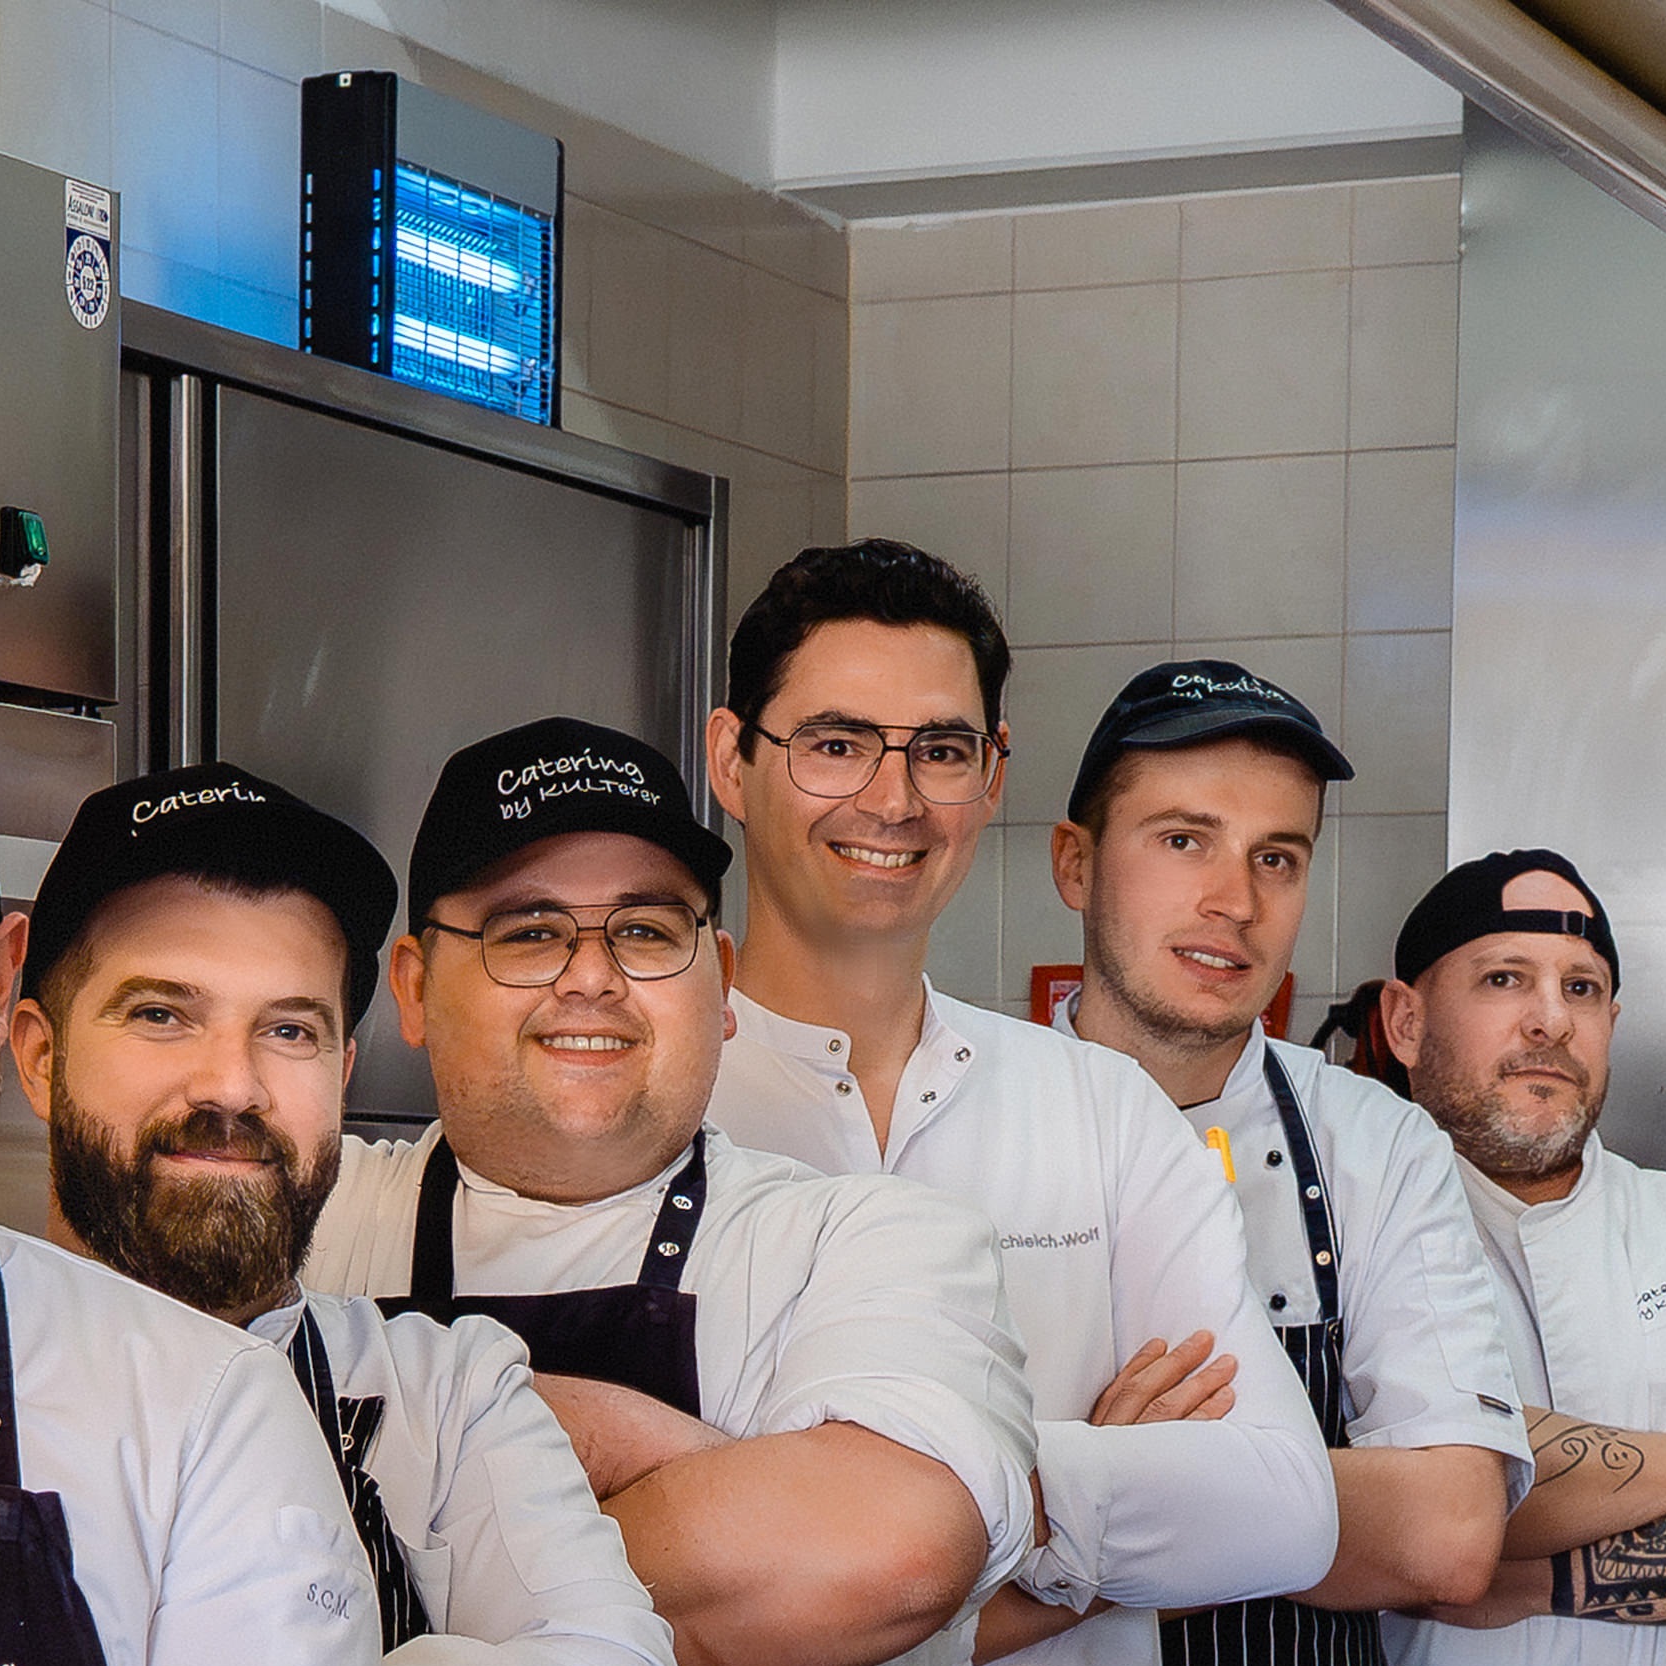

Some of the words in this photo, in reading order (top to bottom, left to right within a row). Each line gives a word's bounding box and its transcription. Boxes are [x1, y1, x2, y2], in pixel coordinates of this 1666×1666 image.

[497, 747, 645, 795] Catering
[500, 796, 532, 820] by
[540, 777, 661, 805] KULTerer
